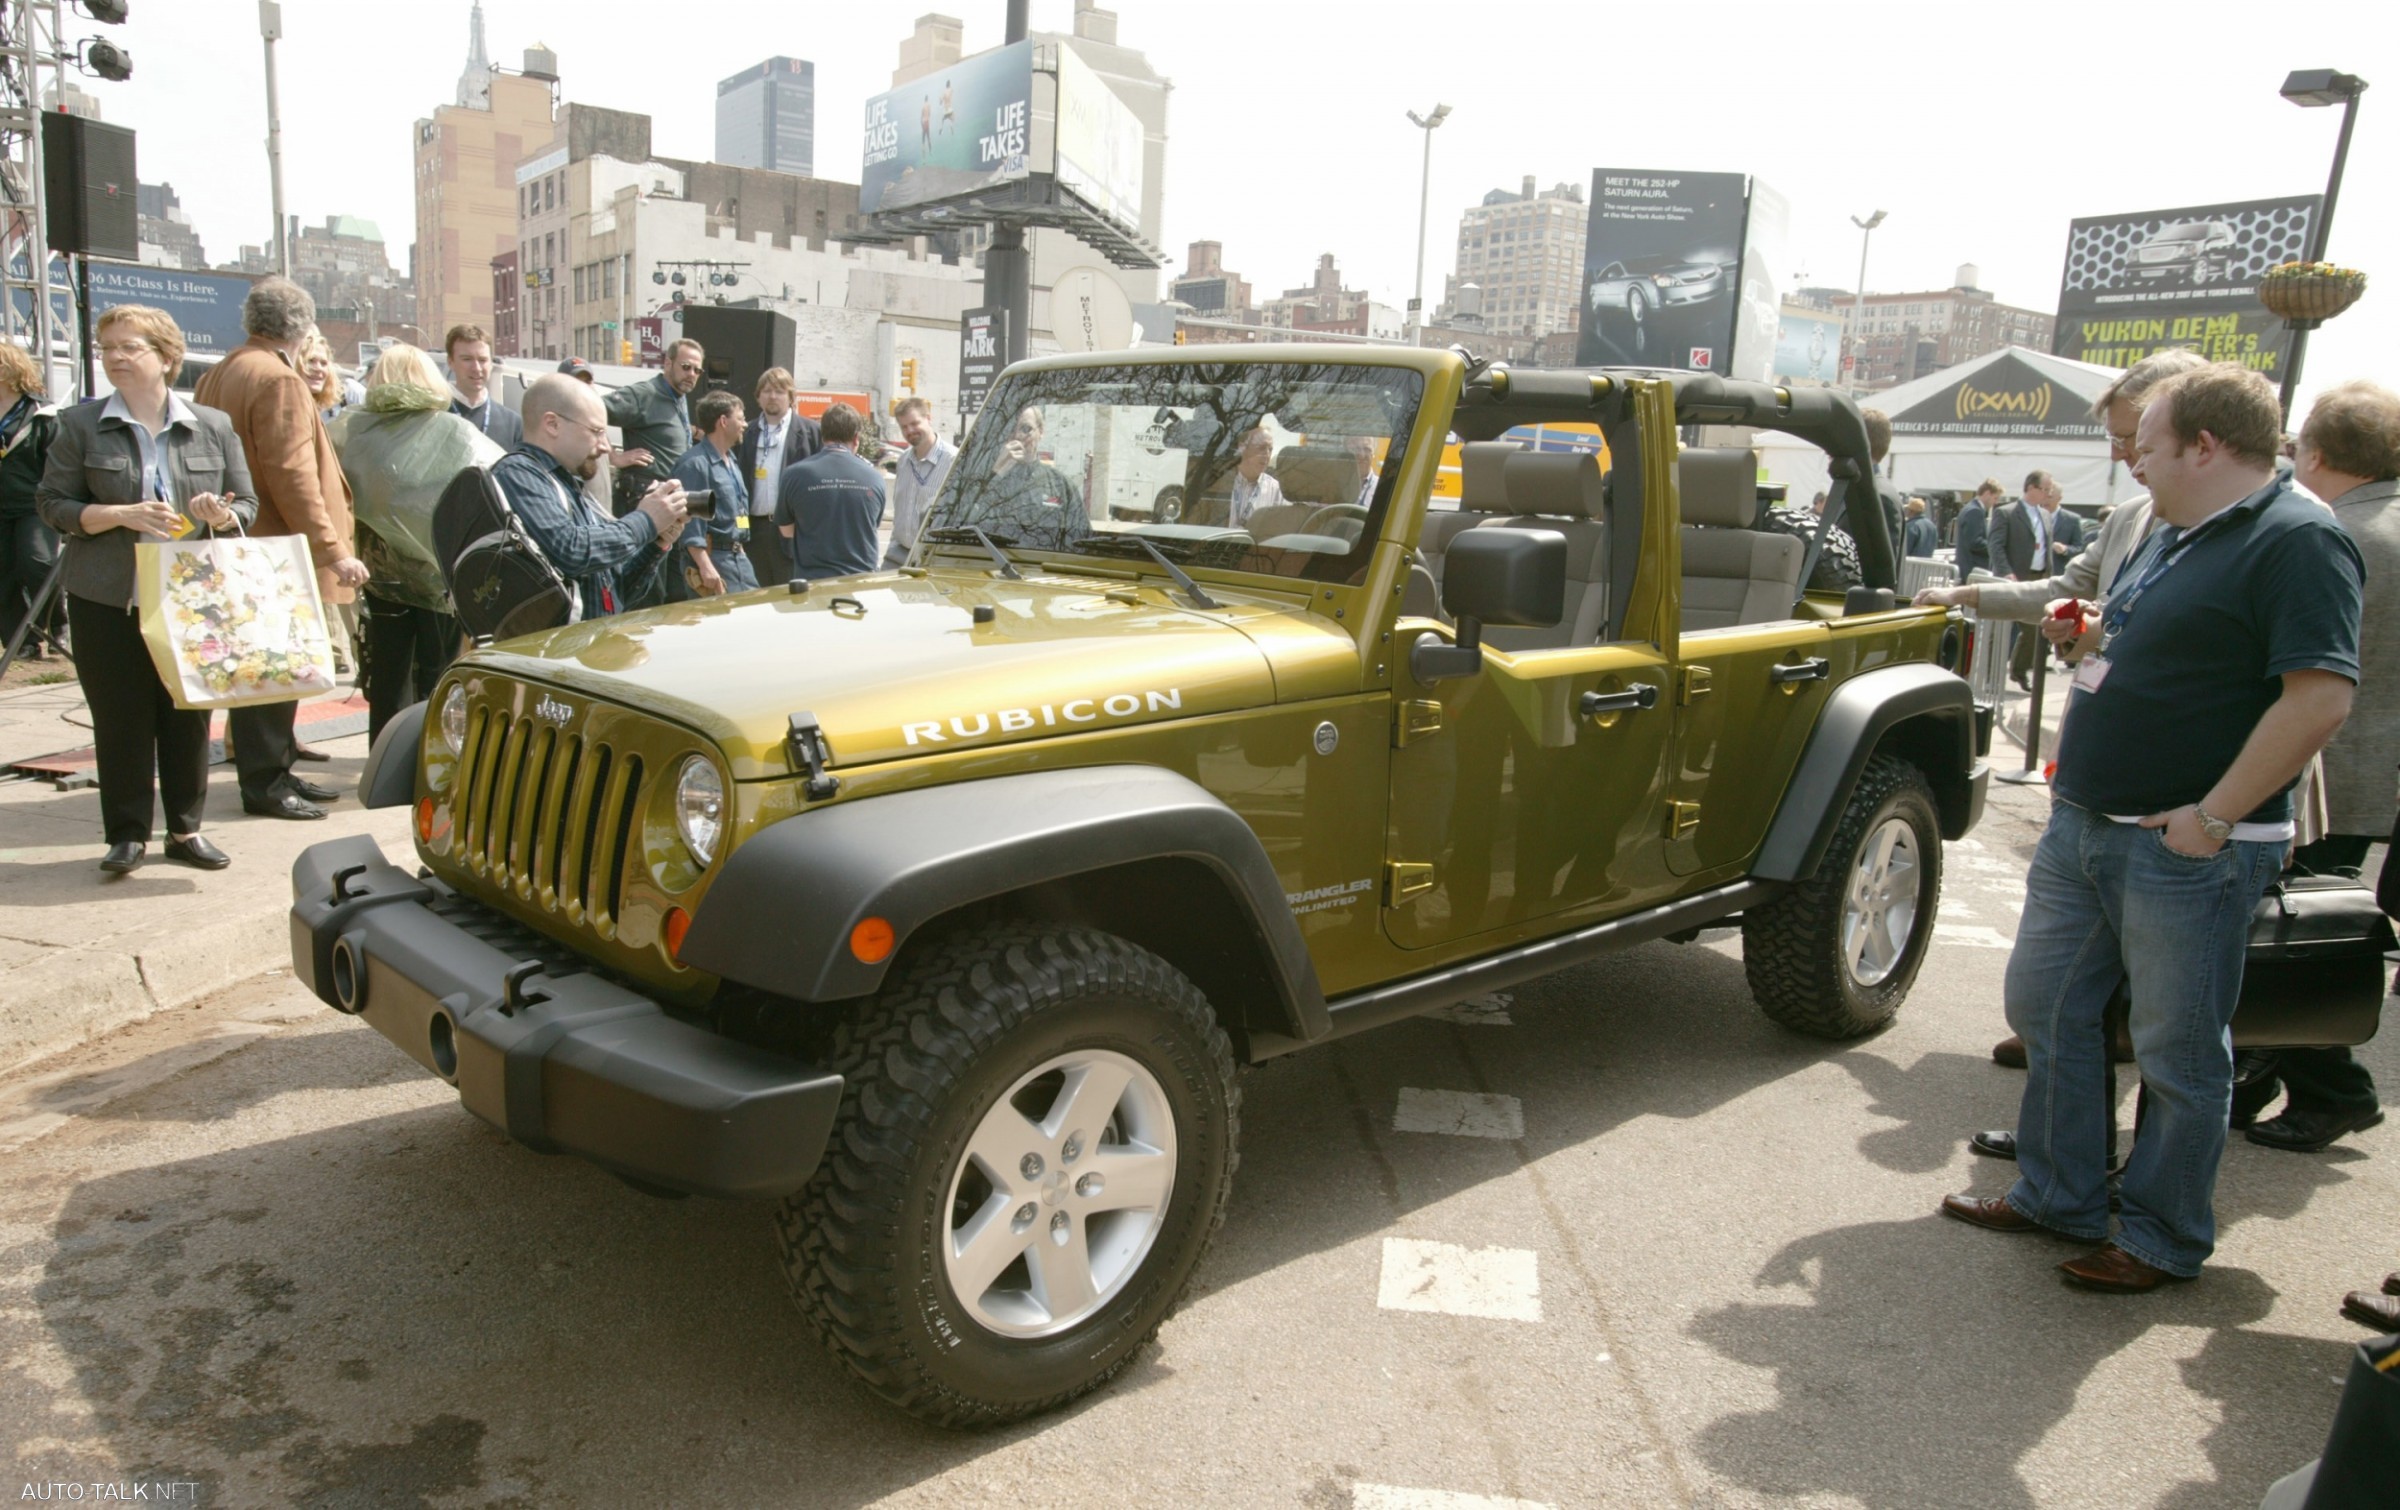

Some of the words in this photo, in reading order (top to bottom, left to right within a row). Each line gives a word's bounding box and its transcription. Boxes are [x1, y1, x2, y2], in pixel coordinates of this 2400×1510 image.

[866, 100, 888, 129] LIFE
[996, 101, 1025, 132] LIFE
[865, 121, 898, 154] TAKES
[979, 128, 1025, 162] TAKES
[865, 150, 887, 167] LETTING
[888, 147, 898, 159] GO
[1002, 155, 1024, 173] VISA
[1604, 187, 1640, 198] SATURN
[1641, 190, 1669, 198] AURA.
[1605, 177, 1629, 186] MEET
[1632, 178, 1648, 187] THE
[1650, 179, 1680, 188] 252-HP
[48, 270, 66, 280] ew
[108, 273, 163, 290] M-Class
[167, 279, 179, 292] Is
[183, 281, 219, 296] Here.
[2095, 294, 2135, 304] INTRODUCING
[2135, 293, 2148, 302] THE
[2147, 291, 2175, 301] ALL-NEW
[2208, 288, 2230, 297] YUKON
[2082, 319, 2166, 344] YUKON
[964, 338, 995, 358] PARK
[2081, 347, 2144, 369] WITH
[1930, 423, 1940, 433] #1
[1942, 423, 1982, 434] SATELLITE
[1983, 423, 2009, 434] RADIO
[536, 693, 573, 729] Jeep
[901, 688, 1182, 745] RUBICON
